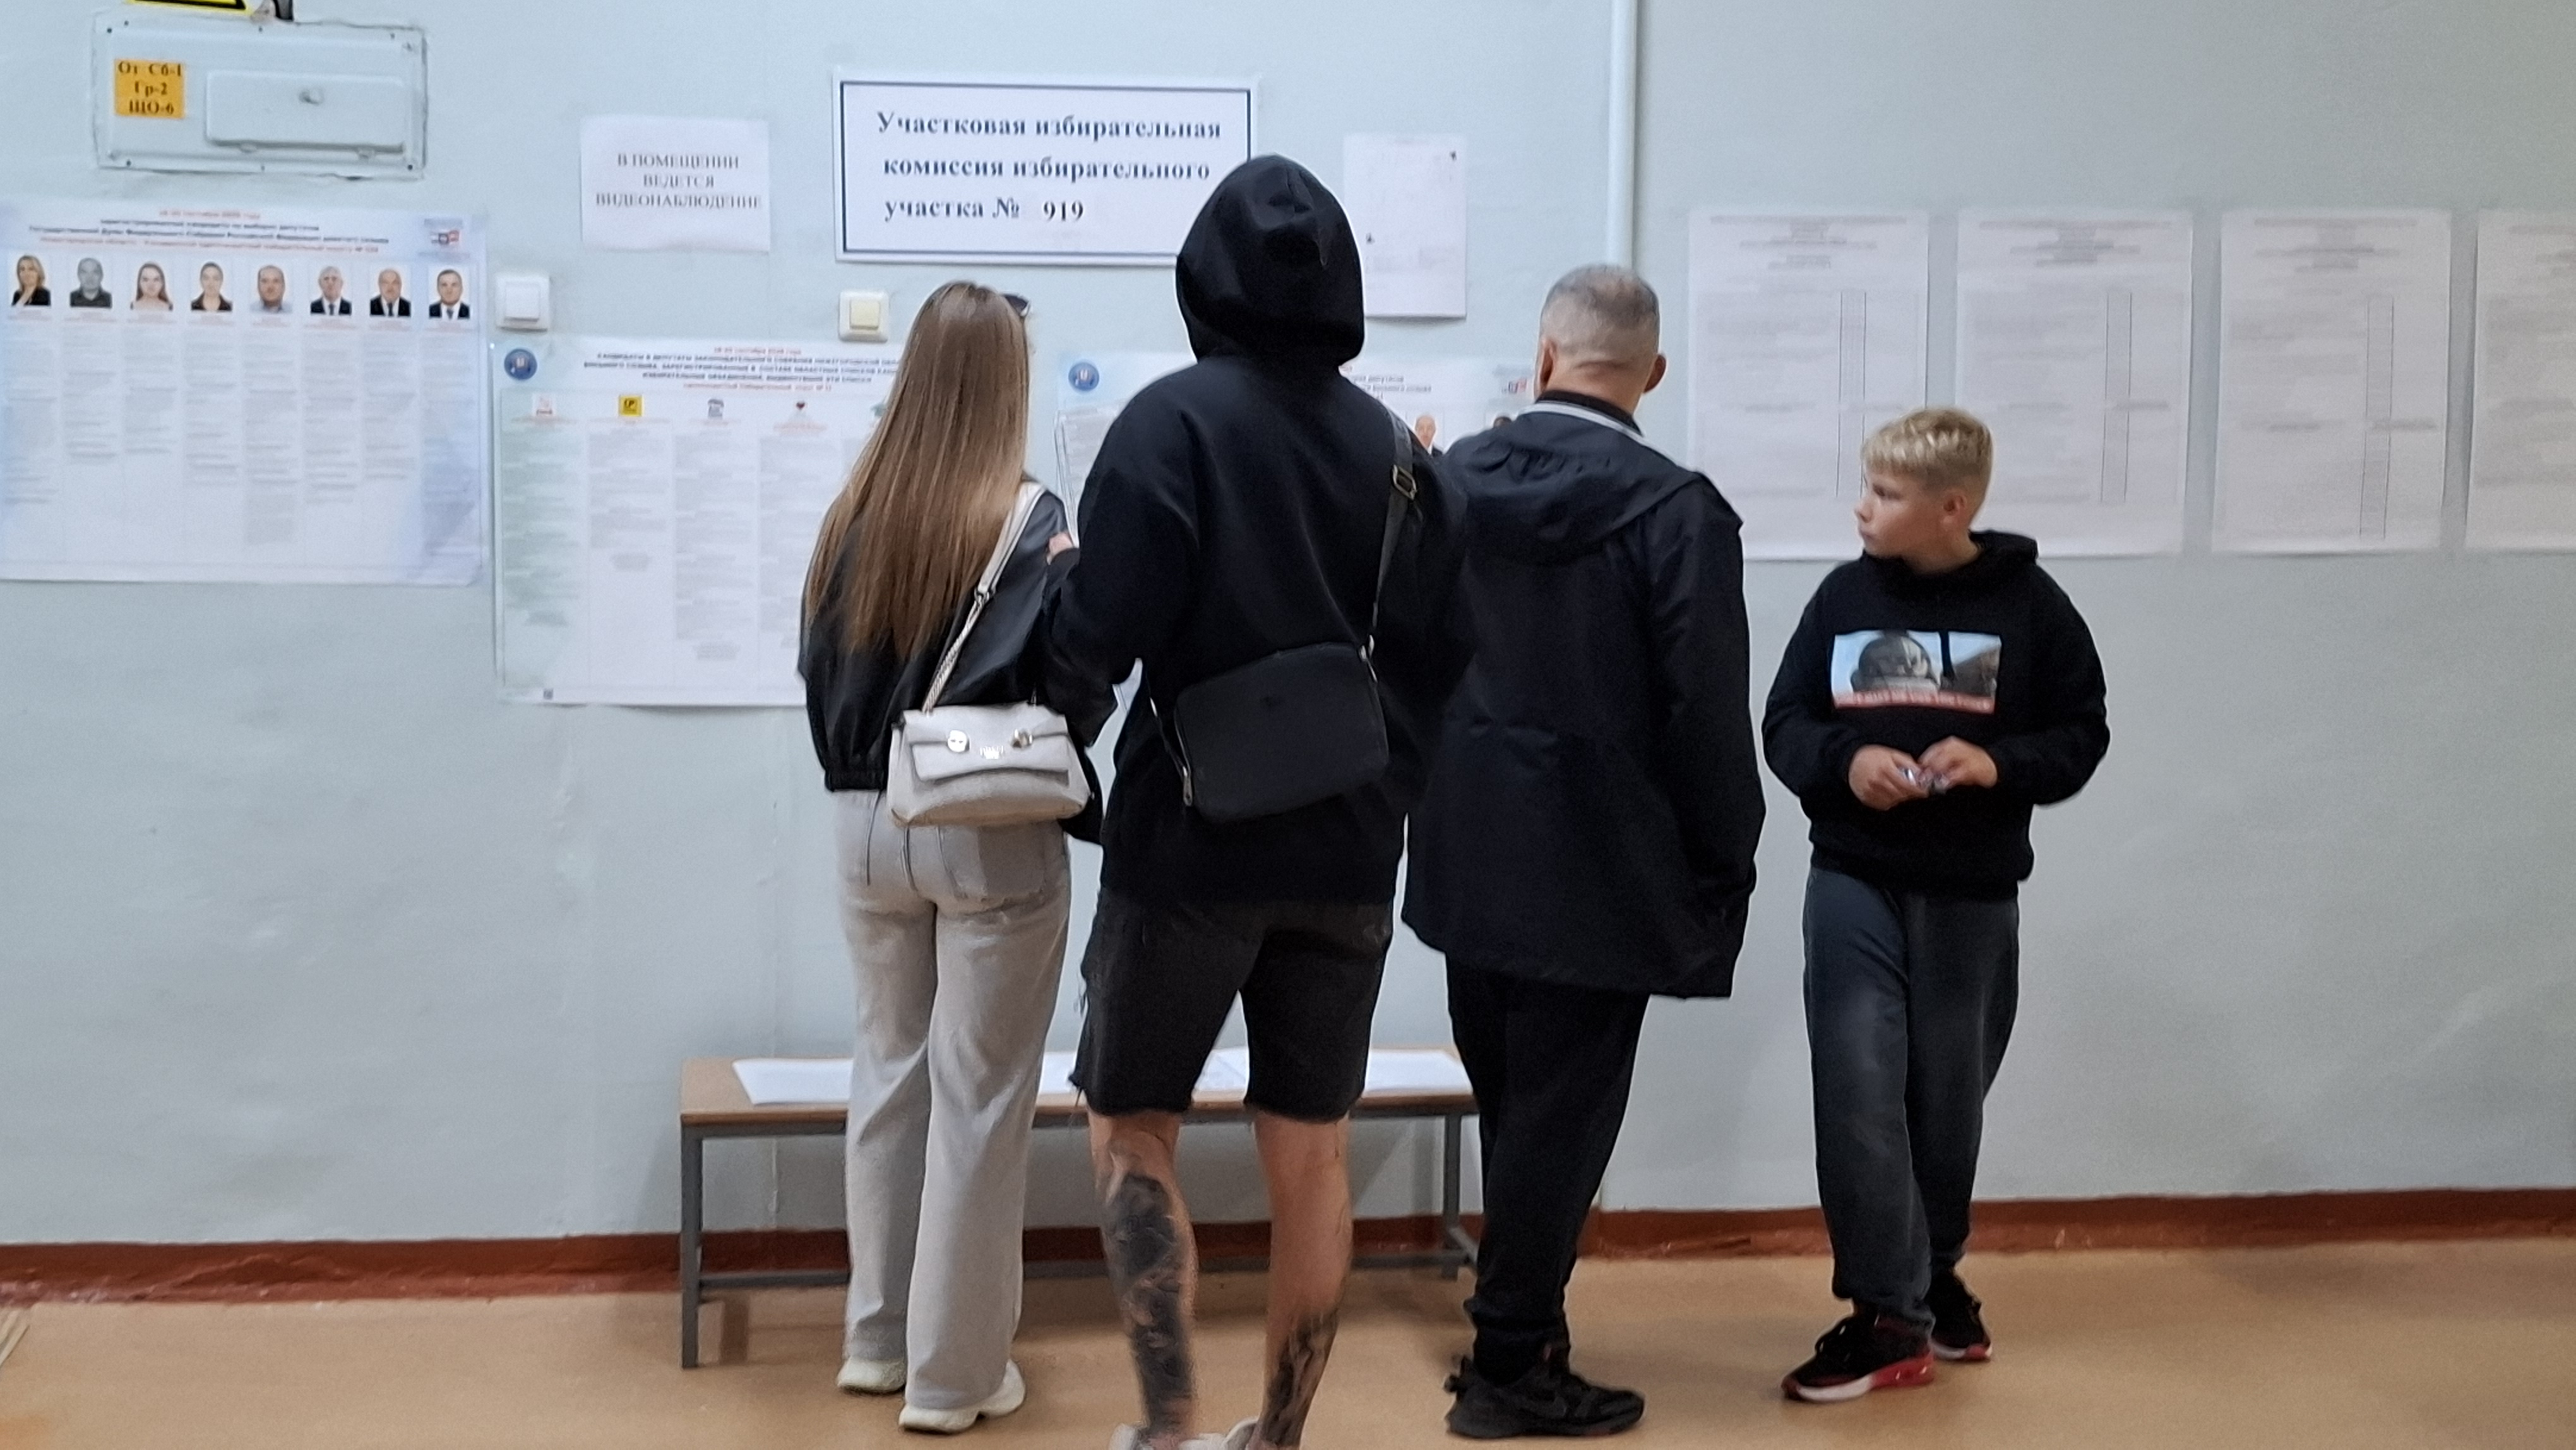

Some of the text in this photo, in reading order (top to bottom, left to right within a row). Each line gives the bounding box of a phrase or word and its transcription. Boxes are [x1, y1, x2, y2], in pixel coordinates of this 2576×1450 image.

[118, 61, 138, 75] От
[877, 111, 1221, 143] Участковая избирательная
[617, 153, 739, 170] В ПОМЕЩЕНИИ
[884, 155, 1210, 183] комиссия избирательного
[643, 174, 715, 189] ВЕДЕТСЯ
[595, 192, 762, 210] ВИДЕОНАБЛЮДЕНИЕ
[885, 196, 1084, 222] участка № 919
